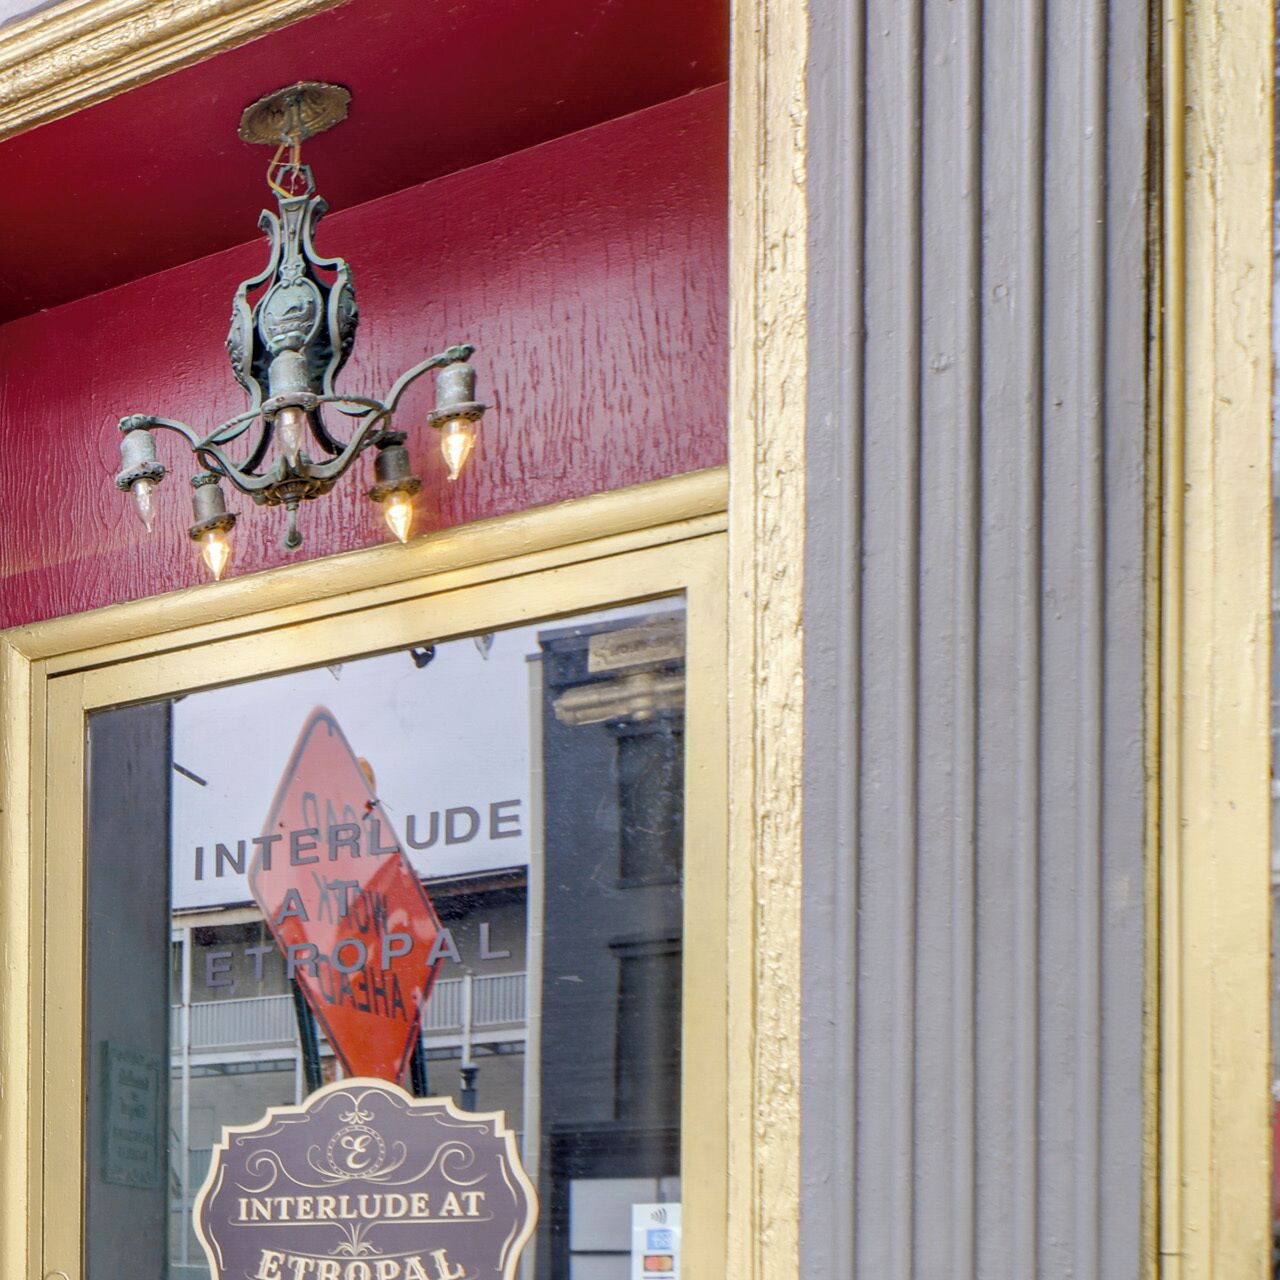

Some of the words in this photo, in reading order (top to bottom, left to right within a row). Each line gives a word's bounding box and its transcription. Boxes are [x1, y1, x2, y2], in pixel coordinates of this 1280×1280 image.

[193, 799, 523, 881] INTERLUDE
[275, 880, 360, 926] AT
[205, 922, 512, 988] ETROPAL
[238, 1193, 430, 1221] INTERLUDE
[441, 1191, 486, 1217] AT
